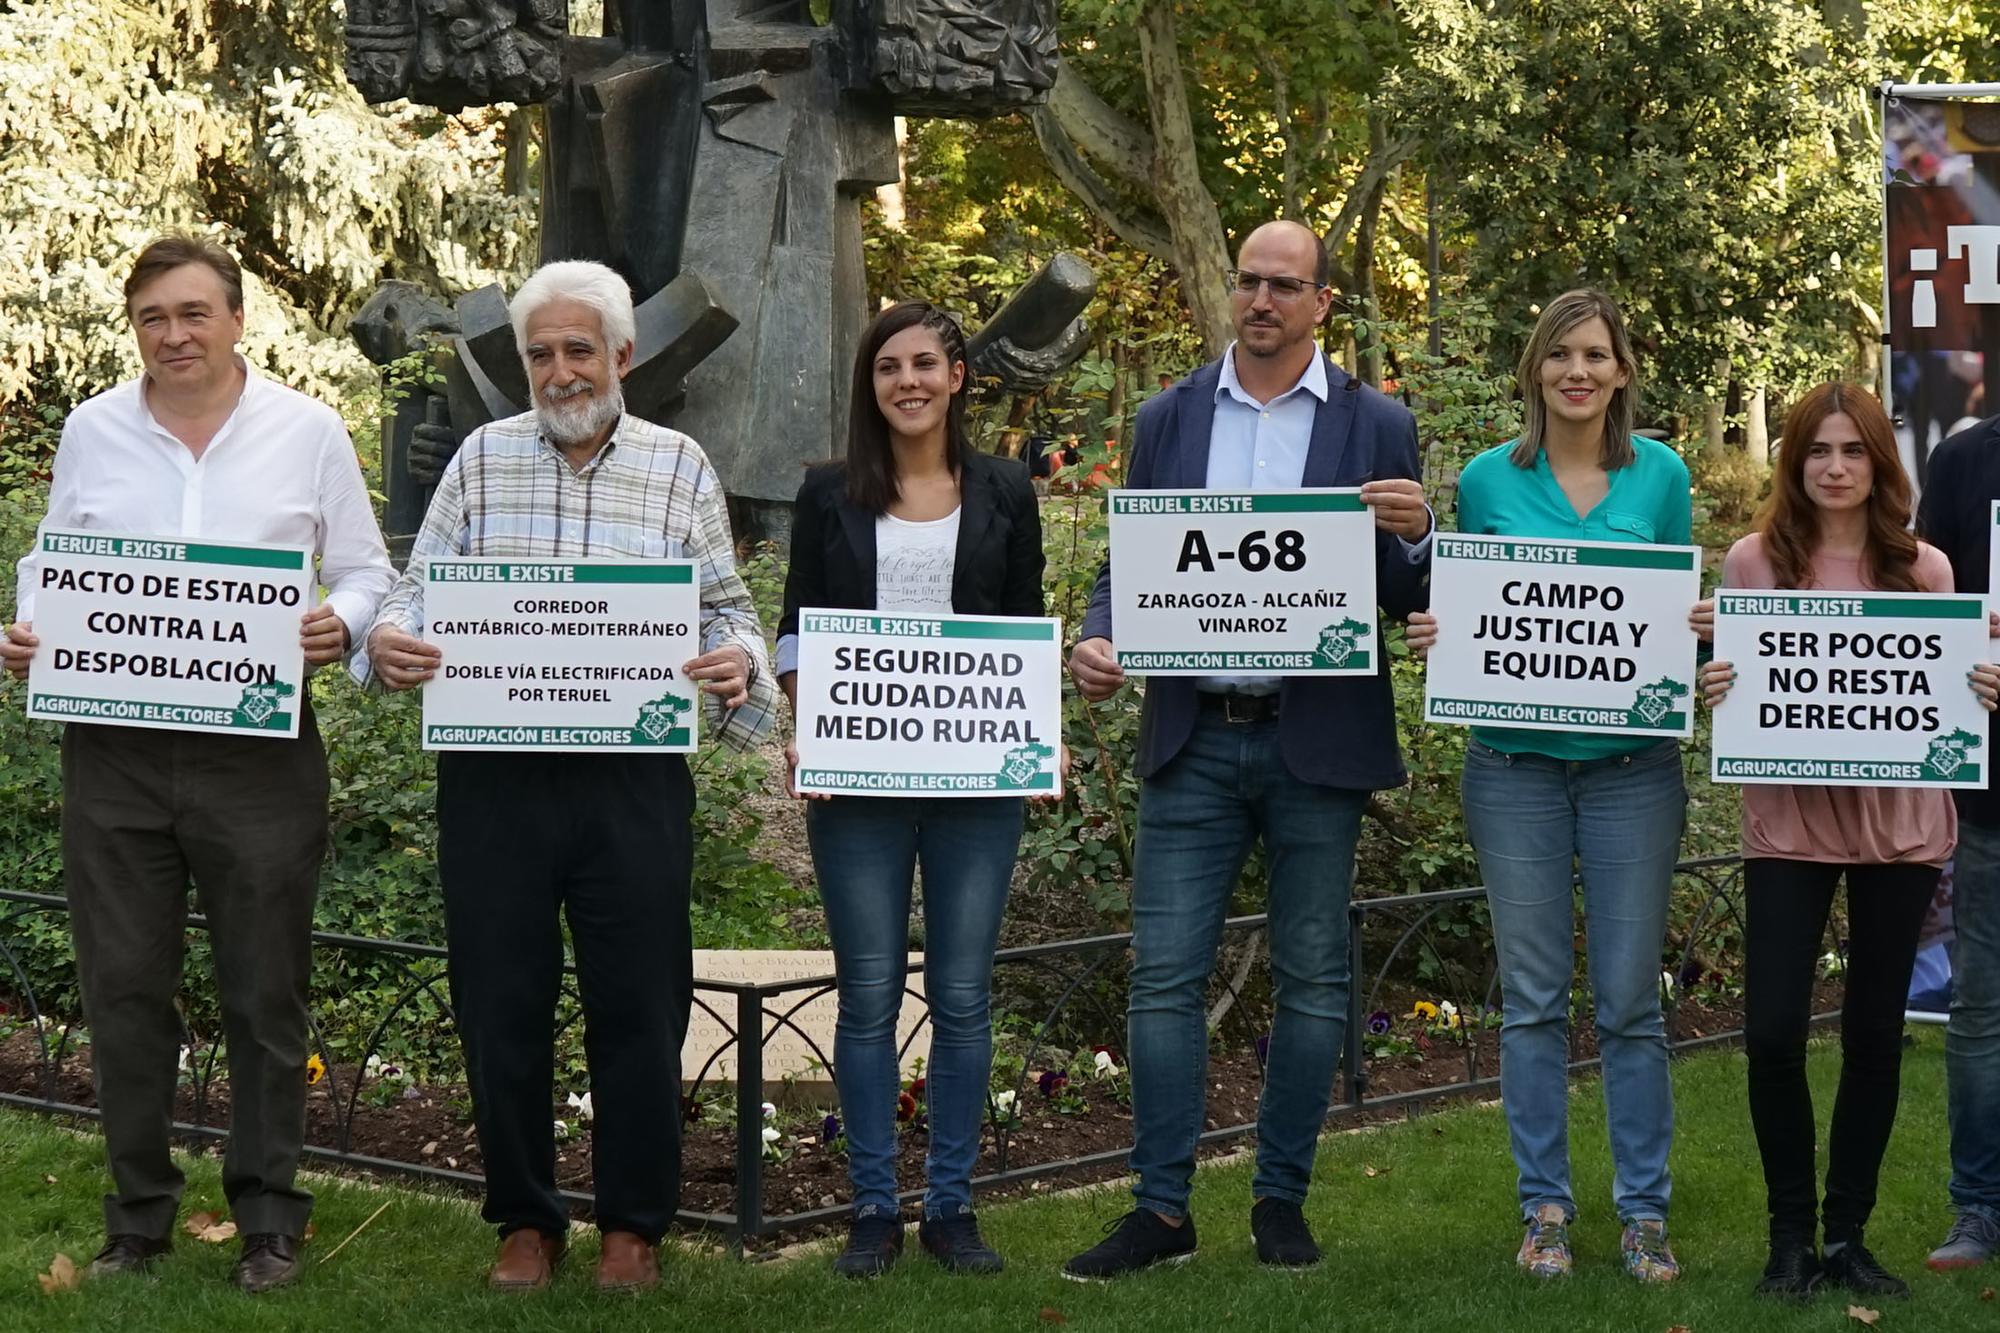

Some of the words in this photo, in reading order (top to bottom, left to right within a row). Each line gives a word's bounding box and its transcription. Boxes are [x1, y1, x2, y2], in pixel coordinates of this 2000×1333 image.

[1116, 498, 1185, 512] TERUEL
[1190, 497, 1252, 512] EXISTE
[46, 535, 117, 556] TERUEL
[124, 541, 186, 560] EXISTE
[1176, 530, 1306, 572] A-68
[1440, 541, 1509, 560] TERUEL
[1514, 546, 1577, 563] EXISTE
[432, 565, 504, 581] TERUEL
[510, 566, 574, 582] EXISTE
[42, 568, 134, 594] PACTO
[143, 575, 179, 598] DE
[188, 579, 300, 607] ESTADO
[1138, 593, 1246, 608] ZARAGOZA
[1263, 589, 1347, 607] ALCAÑIZ
[1502, 581, 1624, 611] CAMPO
[514, 601, 608, 613] CORREDOR
[1722, 598, 1794, 614] TERUEL
[1800, 600, 1863, 615] EXISTE
[88, 612, 203, 640] CONTRA
[213, 621, 247, 643] LA
[433, 619, 688, 636] CANTÁBRICO-MEDITERRÁNEO
[807, 616, 876, 633] TERUEL
[880, 619, 942, 636] EXISTE
[1199, 618, 1287, 632] VINAROZ
[1474, 615, 1619, 647] JUSTICIA
[1628, 624, 1648, 647] Y
[1759, 632, 1818, 657] SER
[1829, 633, 1942, 660] POCOS
[54, 649, 275, 685] DESPOBLACIÓN
[835, 647, 1023, 676] SEGURIDAD
[1121, 652, 1222, 667] AGRUPACIÓN
[1226, 654, 1312, 667] ELECTORES
[1484, 651, 1636, 682] EQUIDAD
[446, 665, 502, 679] DOBLE
[508, 664, 536, 679] VÍA
[542, 667, 674, 680] ELECTRIFICADA
[1769, 668, 1818, 693] NO
[1829, 669, 1930, 695] RESTA
[509, 689, 543, 701] POR
[548, 689, 611, 702] TERUEL
[830, 681, 1026, 709] CIUDADANA
[35, 697, 139, 718] AGRUPACIÓN
[144, 707, 233, 724] ELECTORES
[1433, 701, 1535, 720] AGRUPACIÓN
[1540, 709, 1627, 725] ELECTORES
[1760, 704, 1939, 731] DERECHOS
[431, 727, 537, 743] AGRUPACIÓN
[542, 730, 631, 743] ELECTORES
[816, 715, 923, 741] MEDIO
[933, 720, 1040, 743] RURAL
[803, 772, 906, 788] AGRUPACIÓN
[910, 775, 996, 788] ELECTORES
[1720, 761, 1826, 777] AGRUPACIÓN
[1831, 764, 1920, 778] ELECTORES
